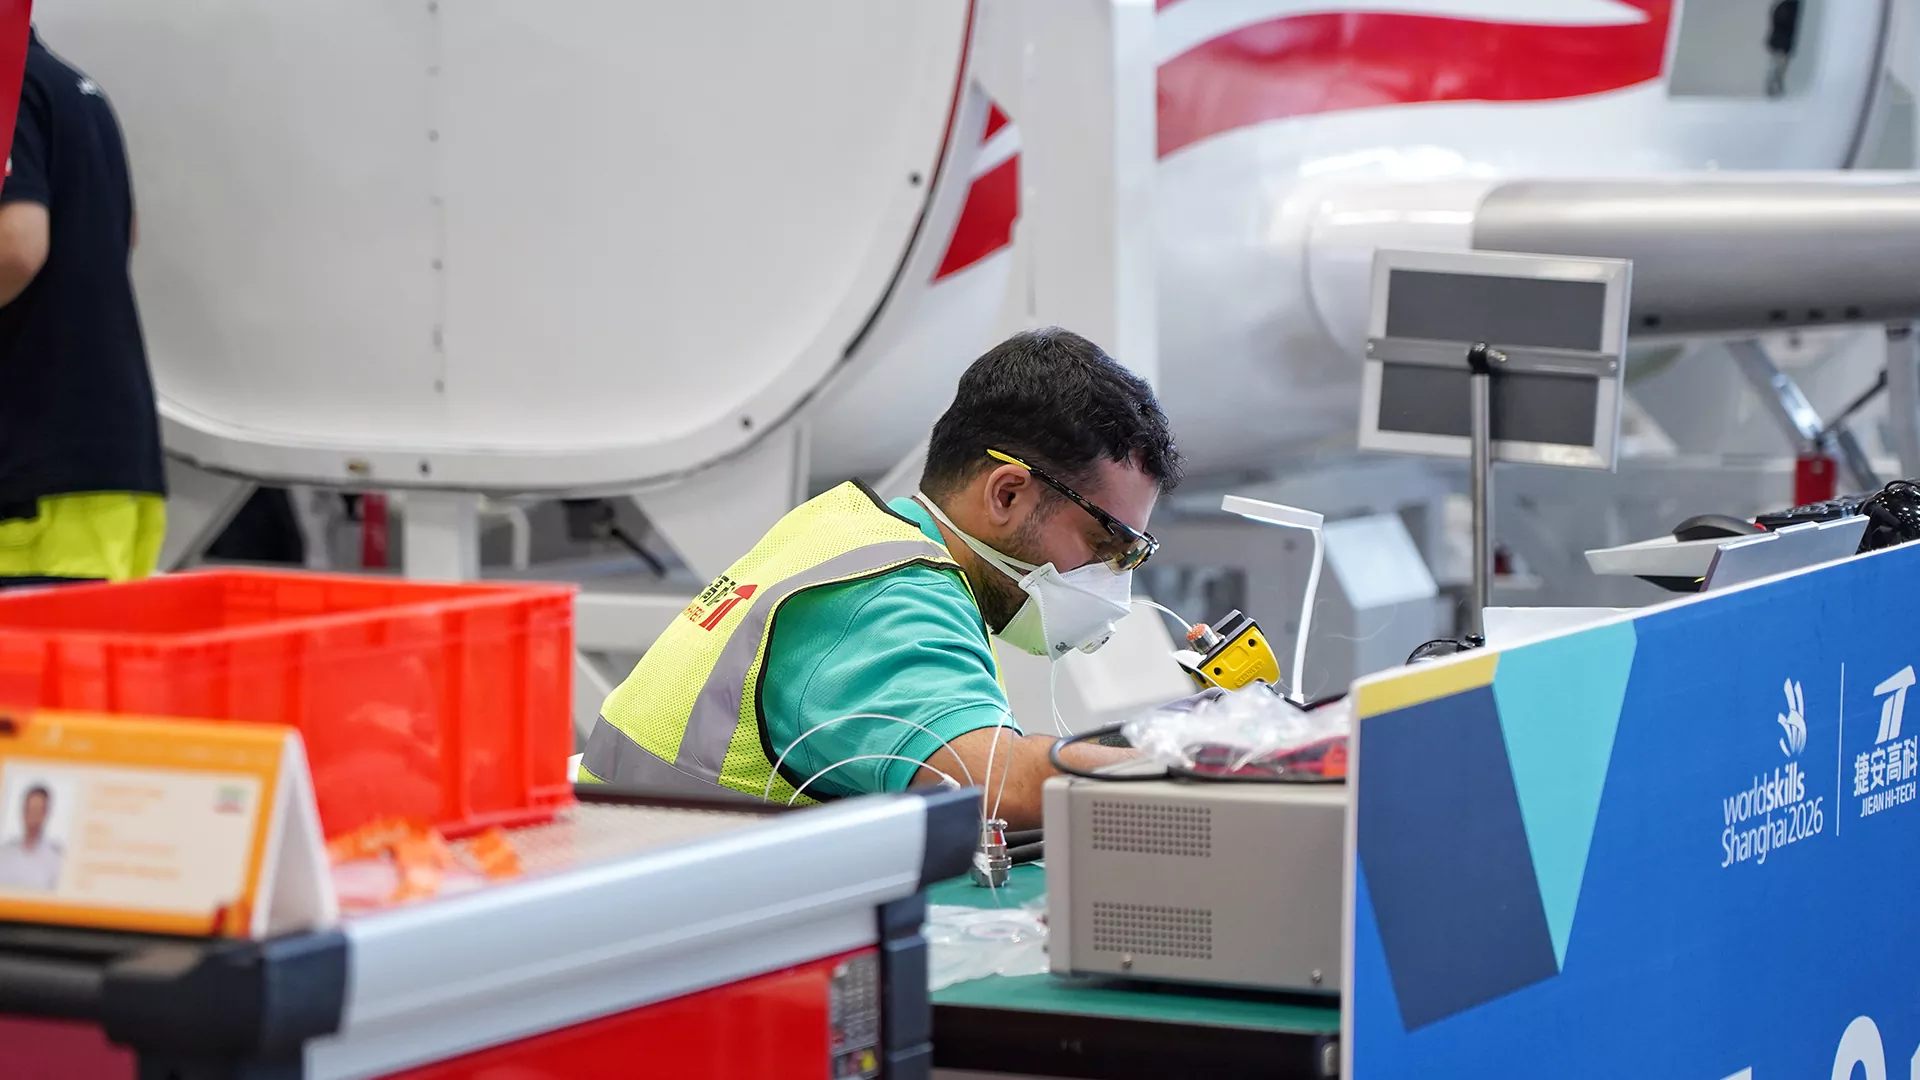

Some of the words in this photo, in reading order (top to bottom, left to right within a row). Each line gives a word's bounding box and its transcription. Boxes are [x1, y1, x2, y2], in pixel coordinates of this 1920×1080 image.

[1723, 761, 1805, 826] worldskills
[1854, 735, 1918, 797] 捷安高科
[1860, 792, 1885, 818] JIEAN
[1884, 781, 1917, 809] HI-TECH
